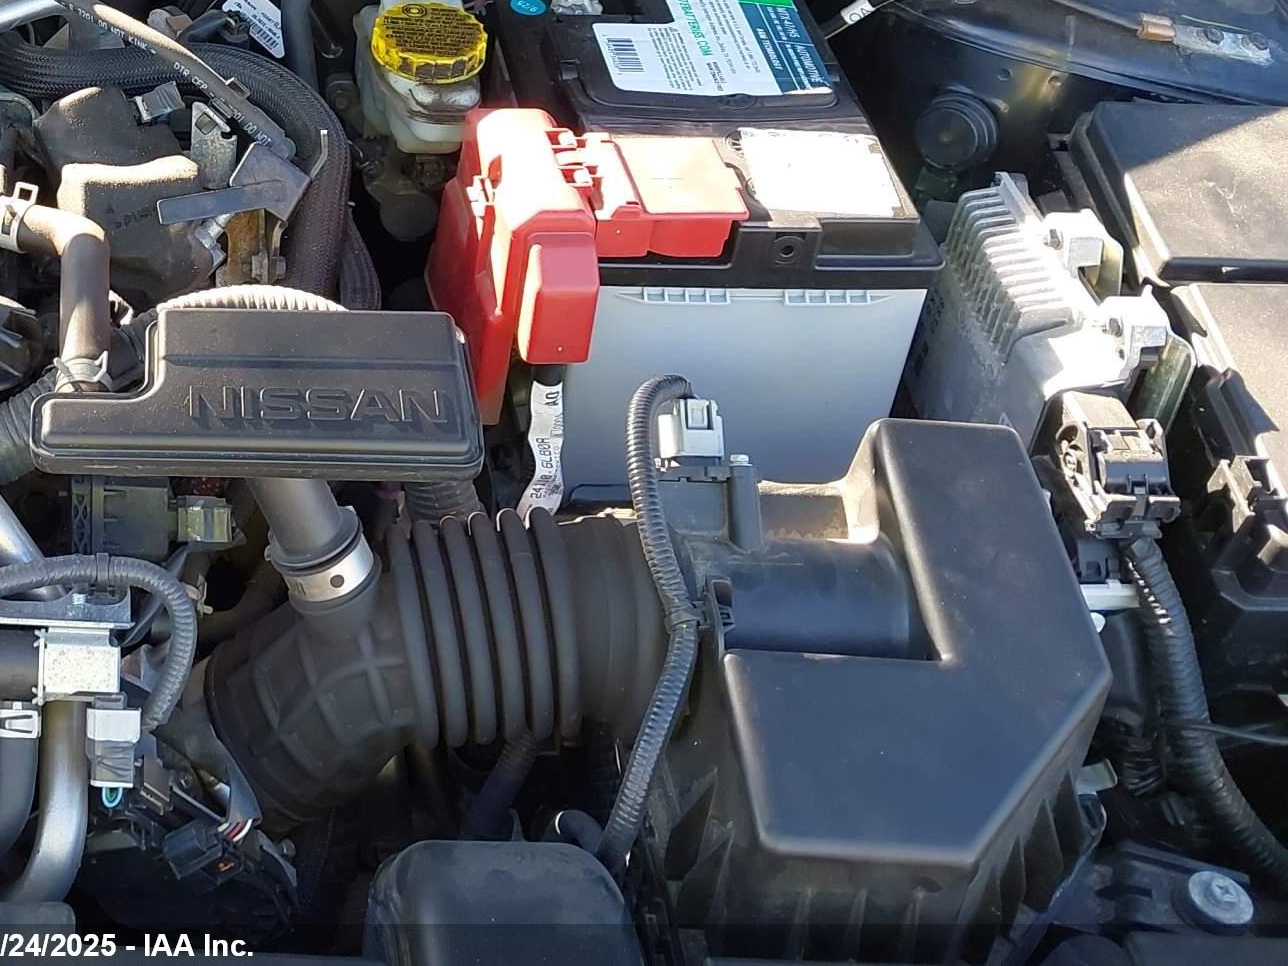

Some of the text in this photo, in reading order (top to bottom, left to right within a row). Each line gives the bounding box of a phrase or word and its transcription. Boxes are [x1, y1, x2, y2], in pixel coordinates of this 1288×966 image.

[173, 61, 190, 78] DTR
[191, 75, 208, 90] CFP
[244, 121, 256, 134] DO
[189, 385, 448, 423] NISSAN
